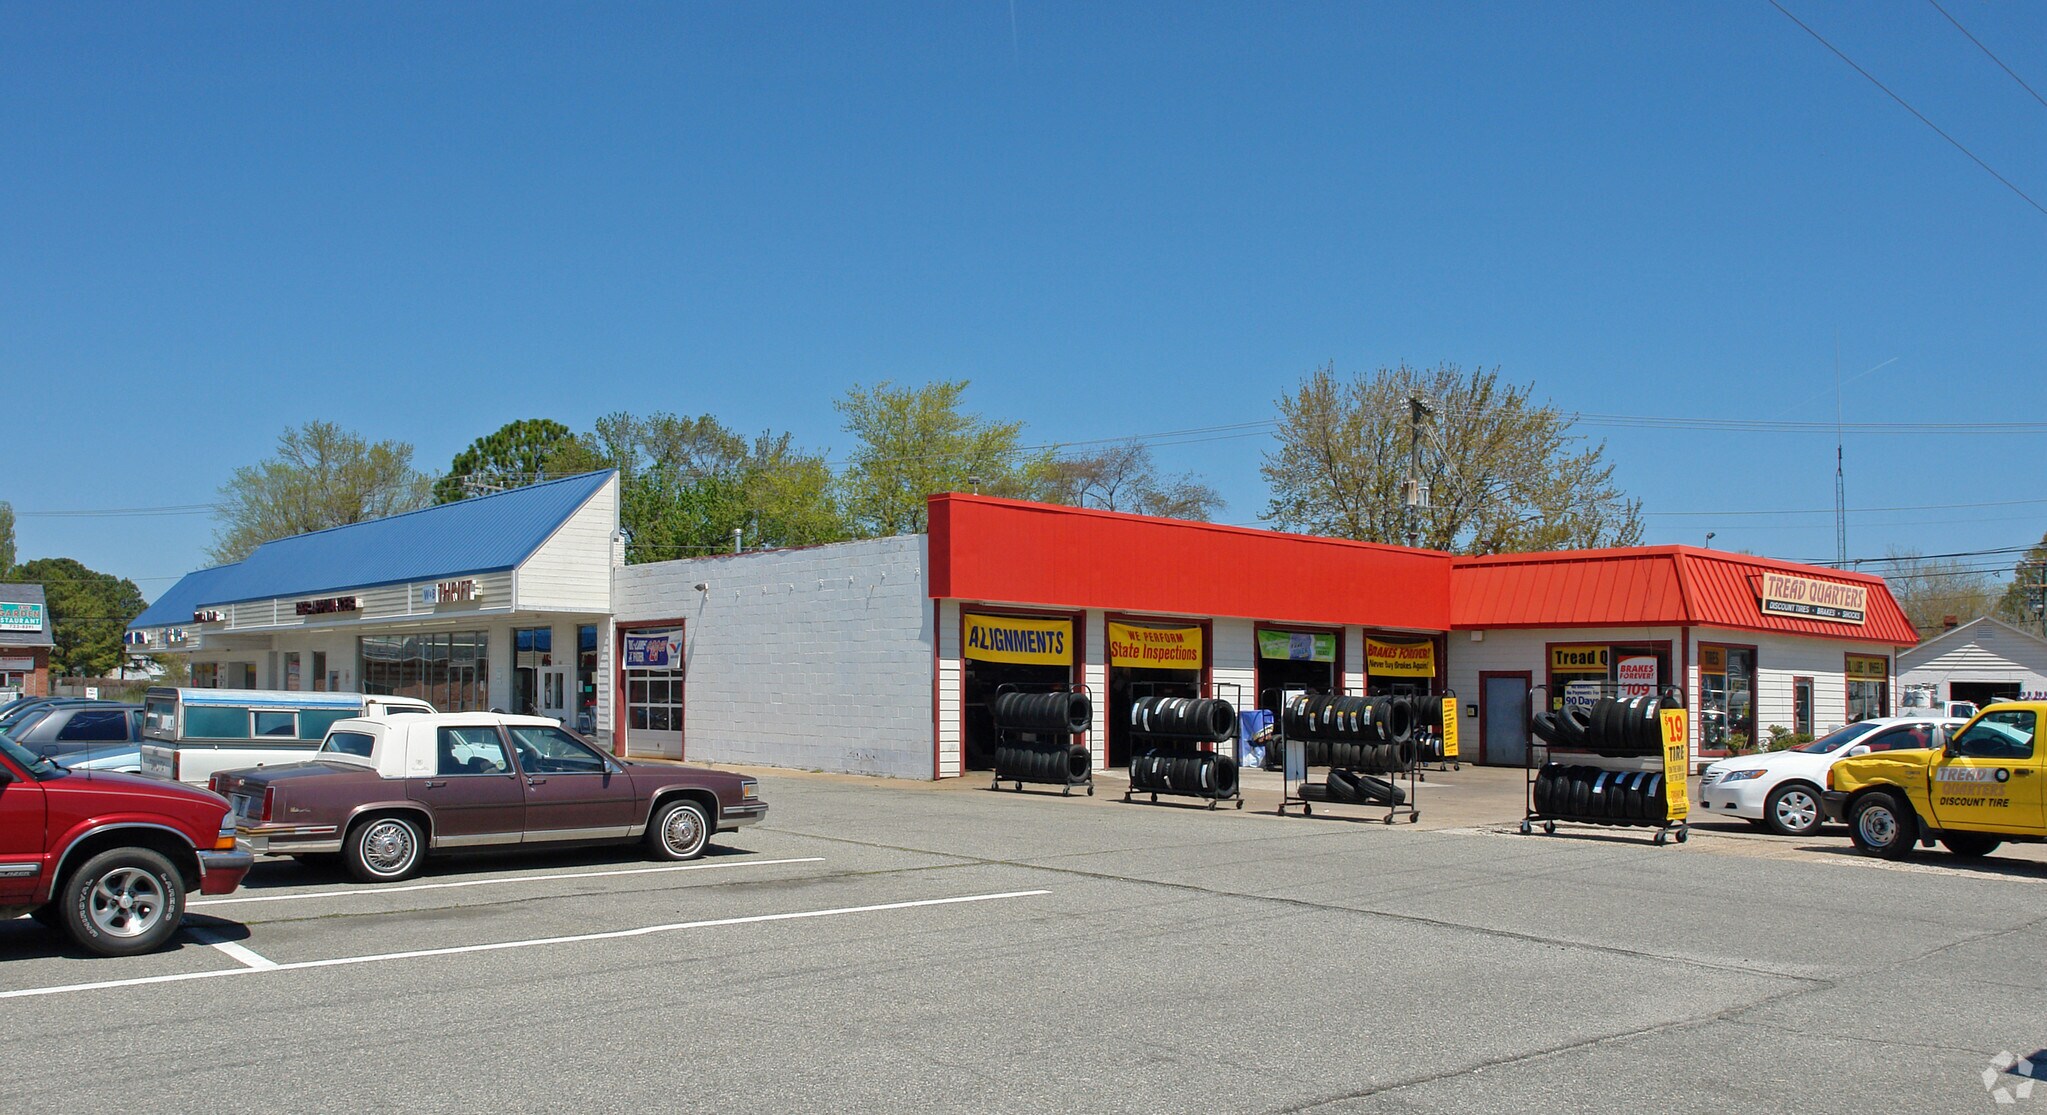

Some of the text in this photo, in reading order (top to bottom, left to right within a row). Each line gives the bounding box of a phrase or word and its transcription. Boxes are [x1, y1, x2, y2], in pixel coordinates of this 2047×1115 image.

[436, 579, 474, 603] THRIFT
[1768, 575, 1864, 608] TREAD QUARTERS
[1769, 601, 1860, 620] DISCOUNT TIRES BRAKES SHOCKS
[968, 625, 1064, 654] ALIGNMENTS
[1128, 631, 1185, 643] WE PERFORM
[1111, 641, 1197, 663] State Inspections
[1367, 643, 1397, 659] BRAKES
[1555, 650, 1596, 665] Tread
[1369, 659, 1384, 669] Never
[1620, 664, 1654, 673] BRAKES
[1619, 672, 1654, 680] FOREVER!
[1566, 696, 1577, 705] 90
[1669, 745, 1685, 762] TIRE
[1939, 768, 1987, 781] TREAD
[1942, 783, 2006, 797] QUARTERS
[1940, 796, 2010, 808] DISCOUNT TIRE
